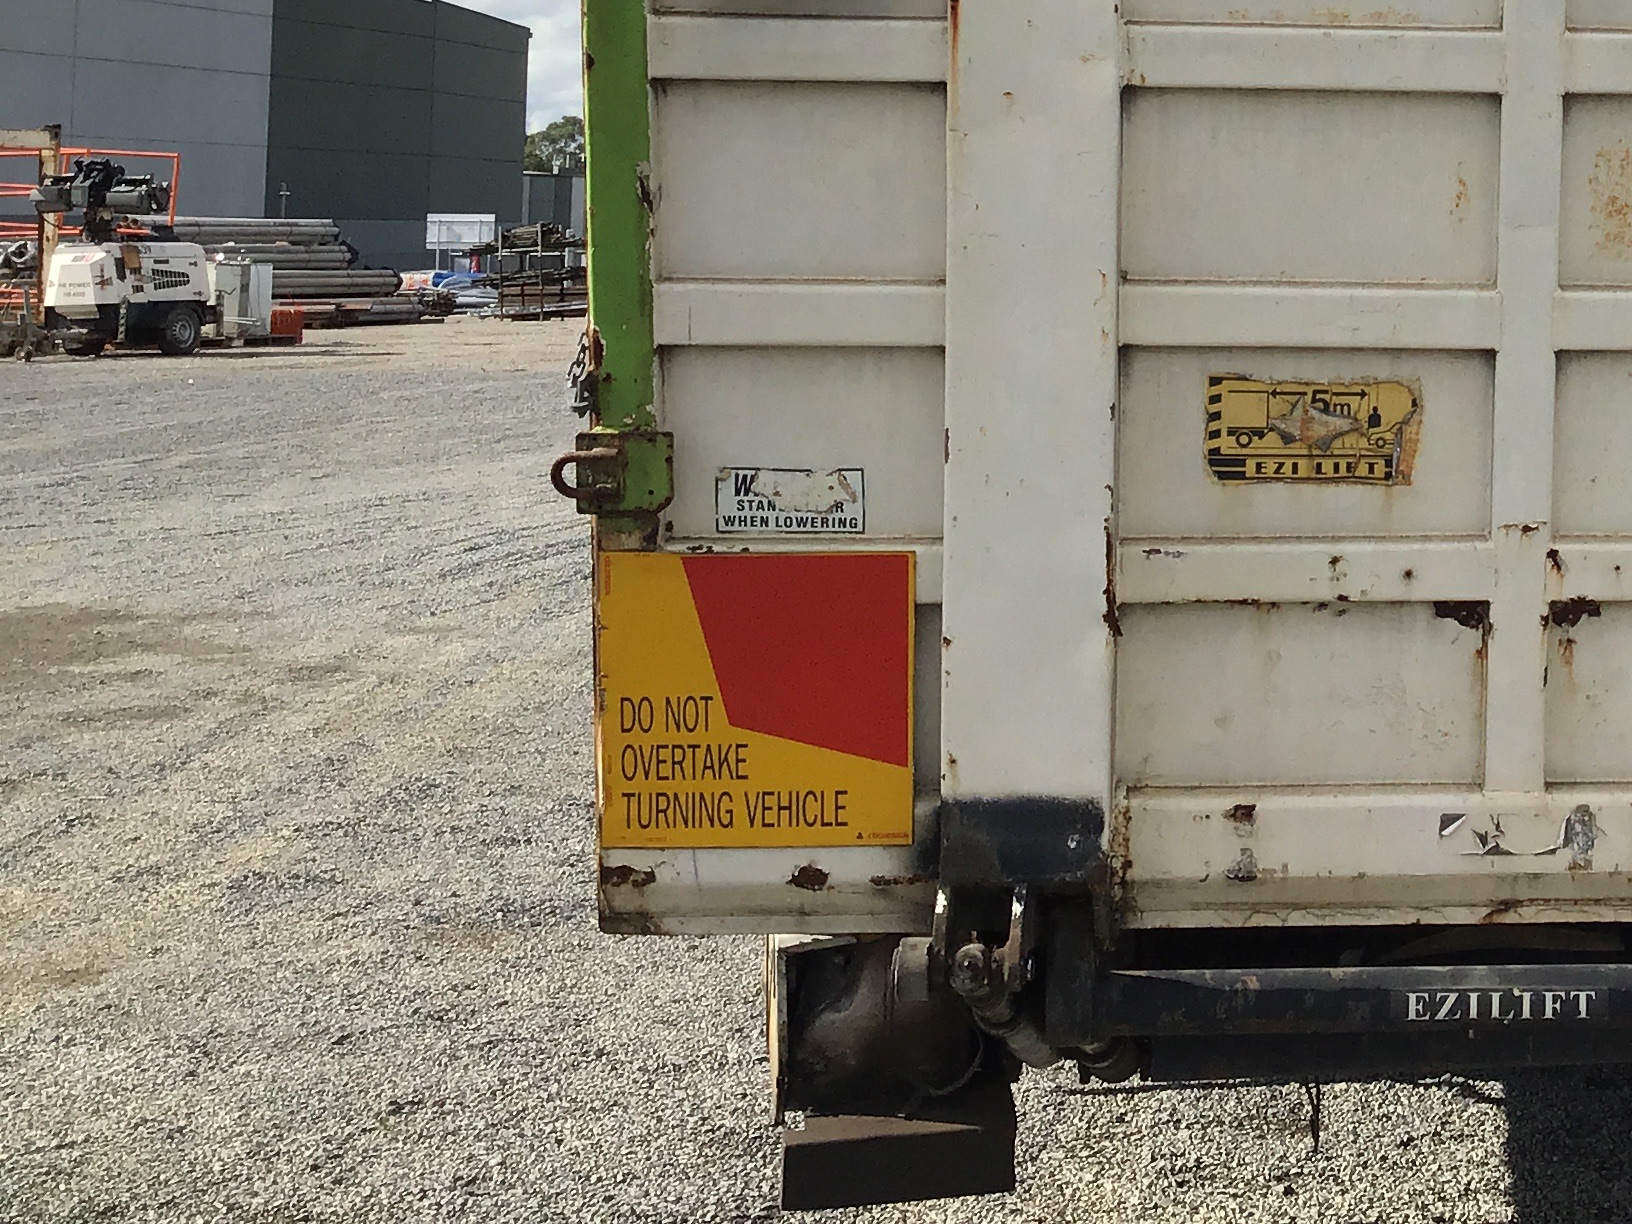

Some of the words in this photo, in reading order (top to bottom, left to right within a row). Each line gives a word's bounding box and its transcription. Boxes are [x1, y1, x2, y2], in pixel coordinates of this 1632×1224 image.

[723, 515, 769, 528] WHEN
[775, 516, 858, 529] LOWERING
[736, 499, 787, 512] STAN
[620, 696, 654, 734] DO
[665, 695, 714, 733] NOT
[621, 742, 749, 781] OVERTAKE
[621, 790, 734, 829] TURNING
[744, 789, 849, 828] VEHICLE
[1406, 990, 1597, 1021] EZILIFT
